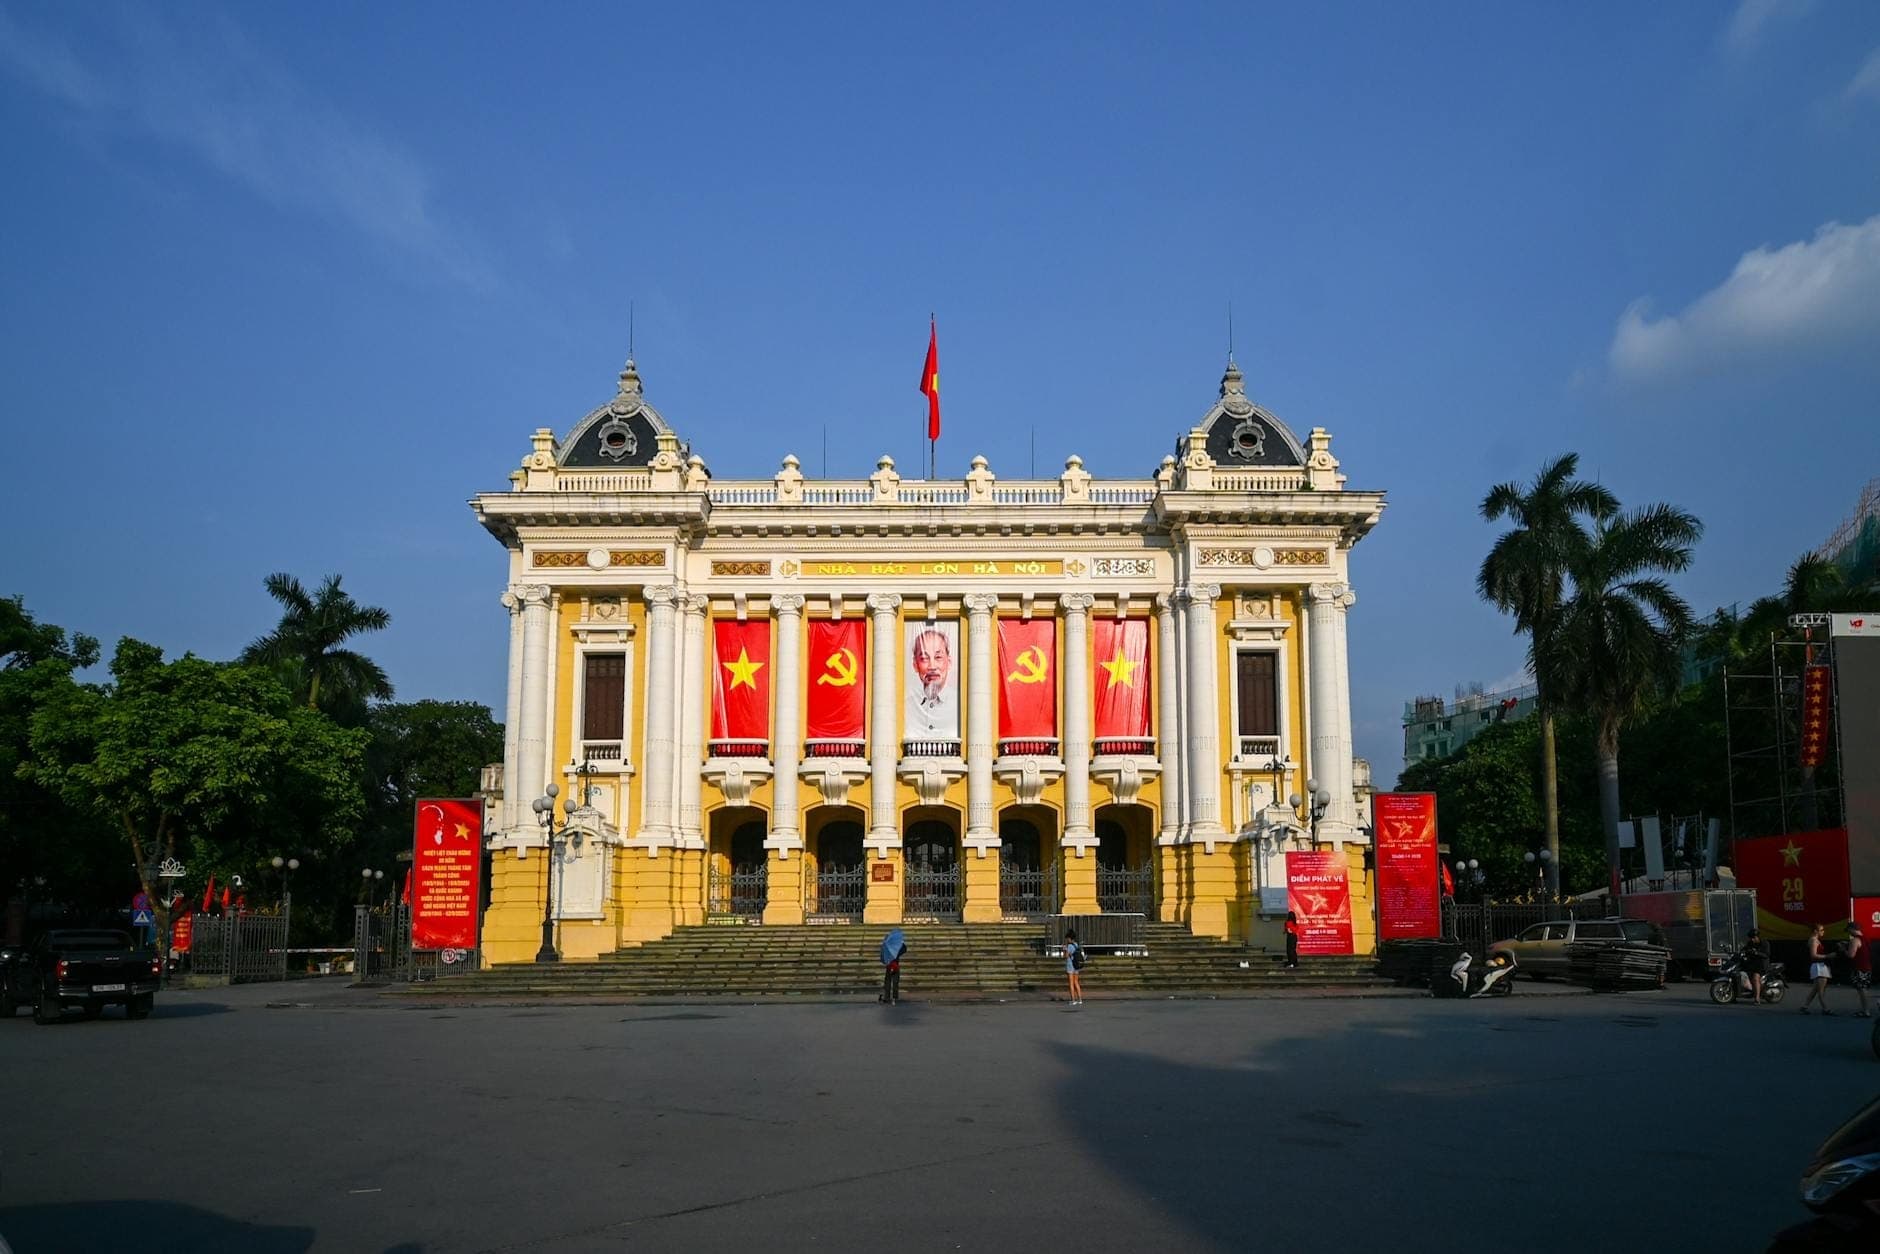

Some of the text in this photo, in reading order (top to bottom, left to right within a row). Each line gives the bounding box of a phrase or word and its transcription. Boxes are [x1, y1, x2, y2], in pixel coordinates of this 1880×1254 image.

[817, 561, 1047, 575] NHÀ HÁT LỚN HÀ NỘI
[1311, 874, 1332, 883] PHÁT
[1782, 878, 1804, 901] 2-9
